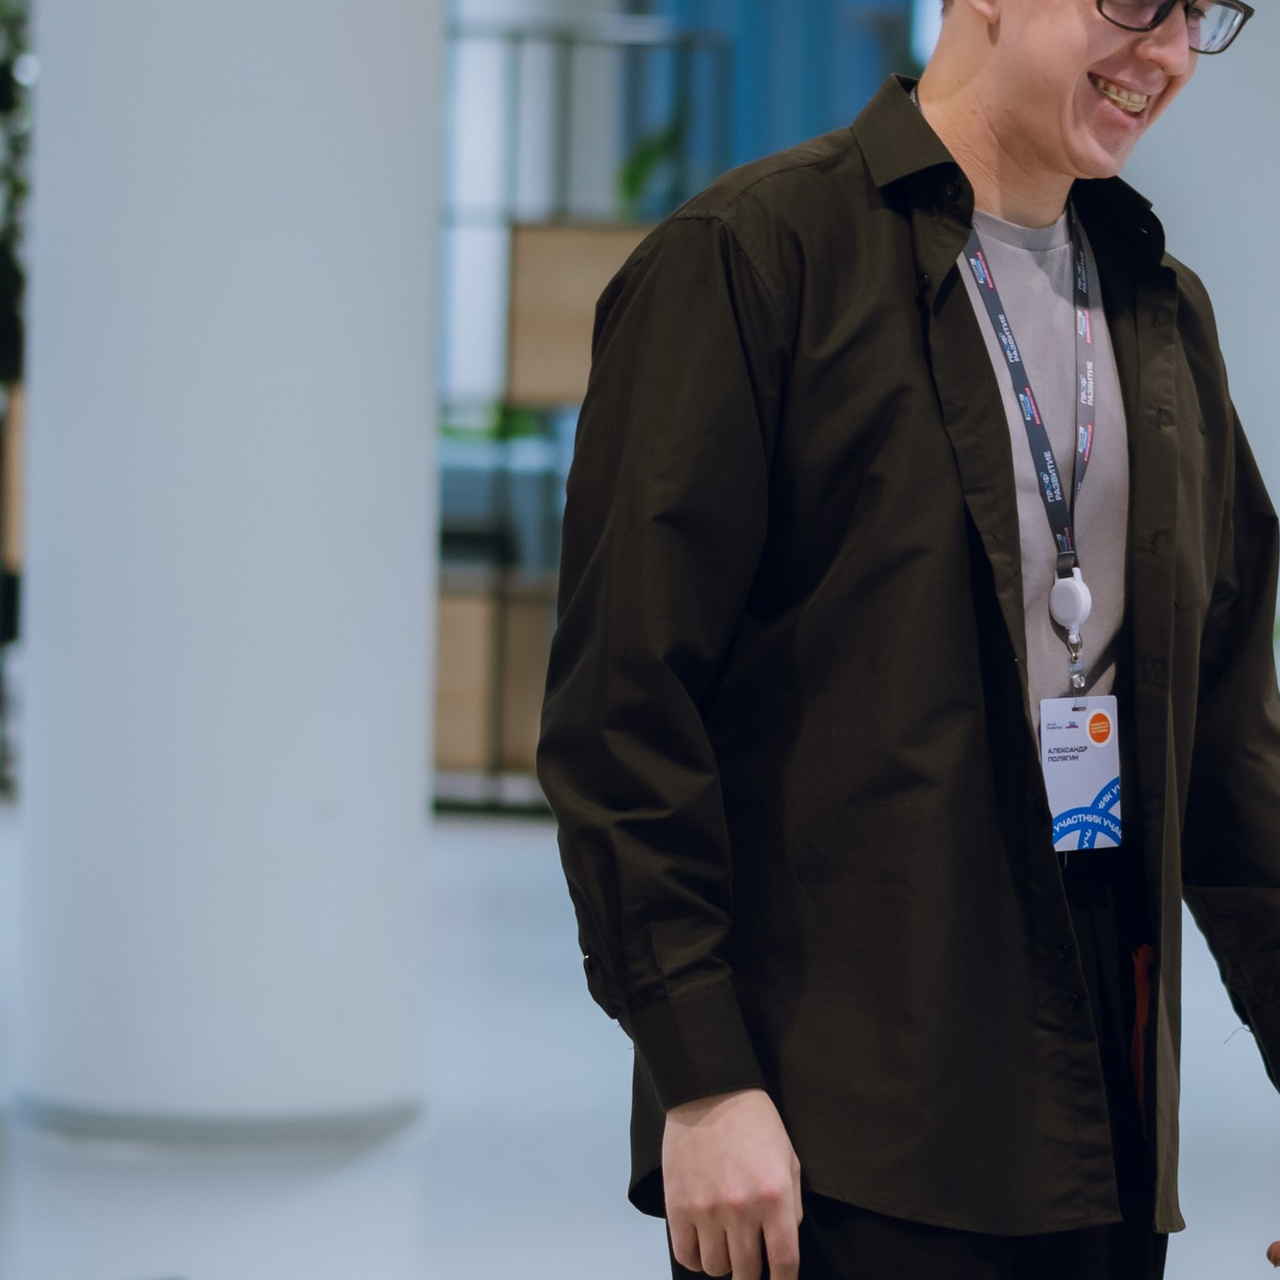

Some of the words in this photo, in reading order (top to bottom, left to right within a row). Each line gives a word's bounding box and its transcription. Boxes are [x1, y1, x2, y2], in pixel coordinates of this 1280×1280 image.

[998, 314, 1020, 362] РАЗВИТИЕ
[1043, 451, 1062, 501] РАЗВИТИЕ
[1047, 746, 1088, 755] АЛЕКСАНДР
[1054, 813, 1103, 832] УЧАСТНИК
